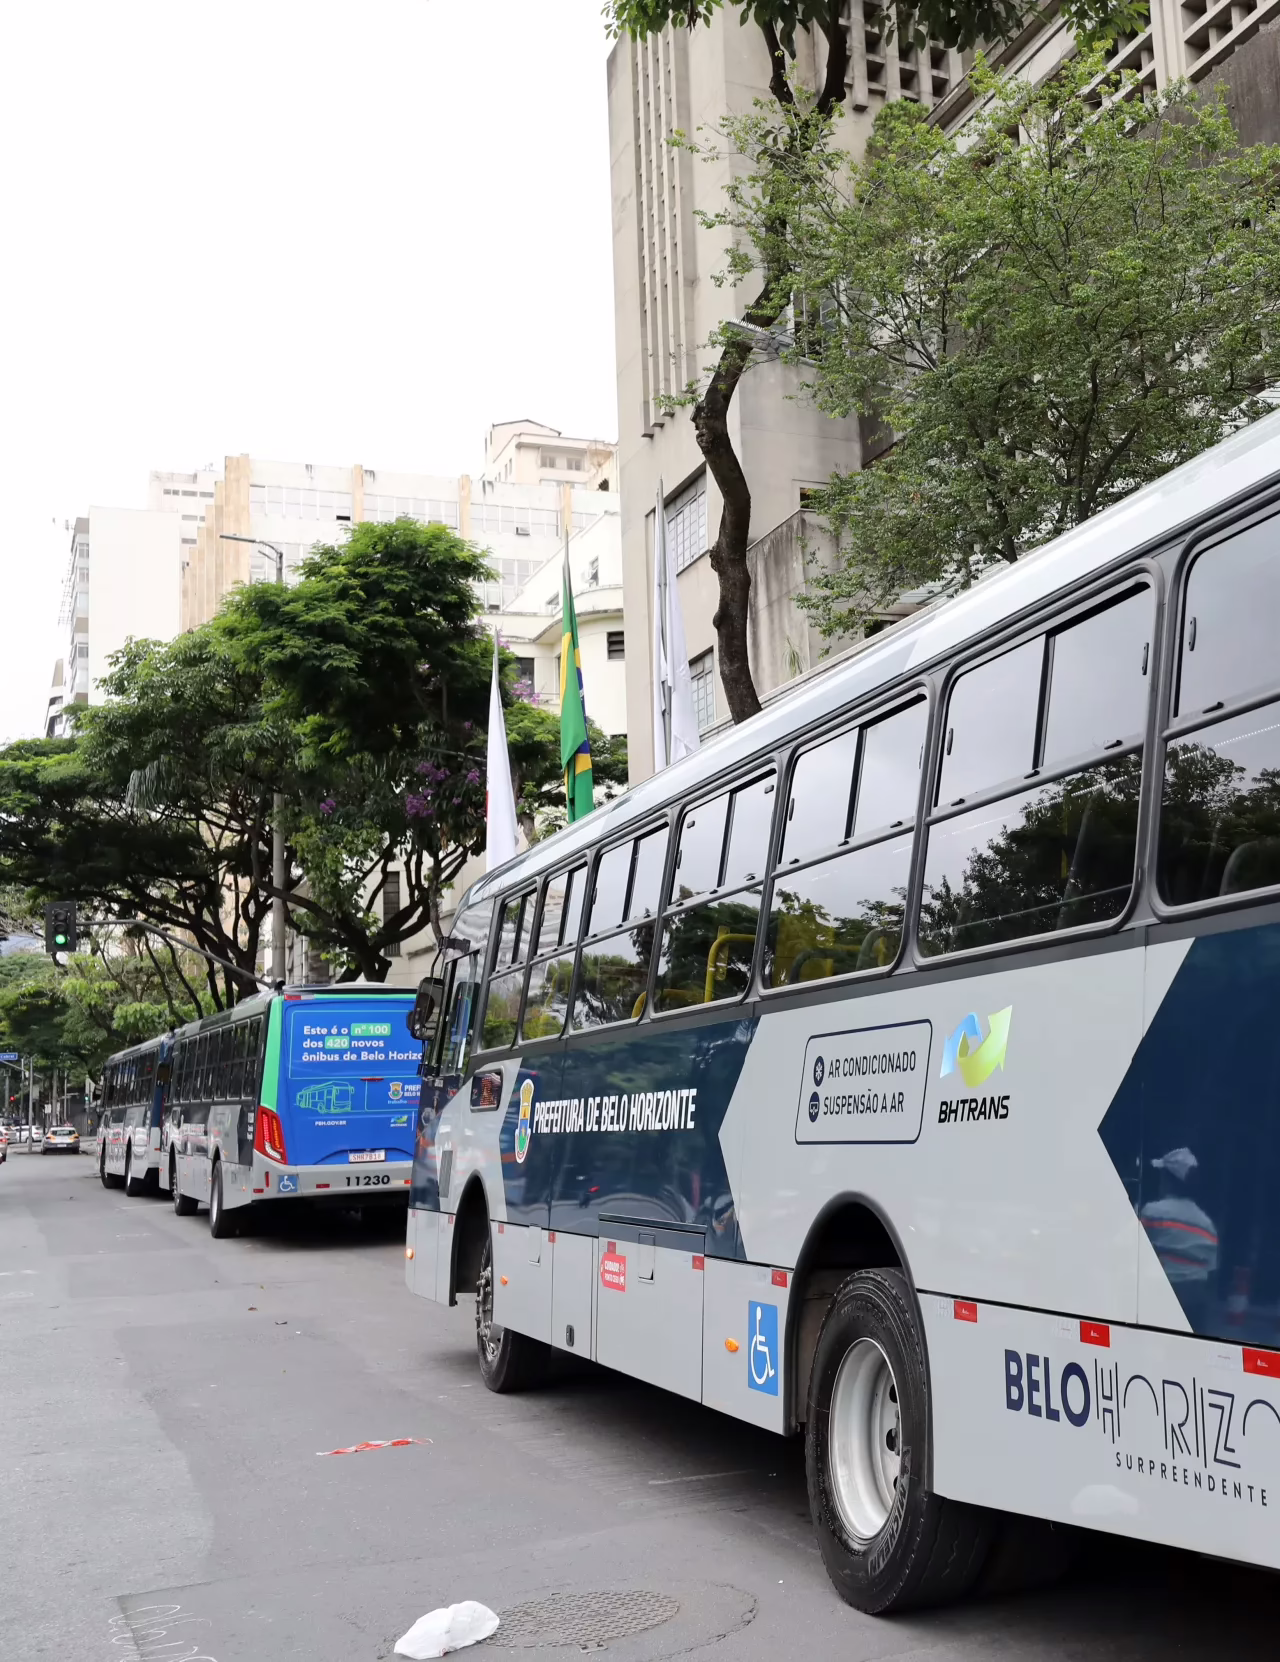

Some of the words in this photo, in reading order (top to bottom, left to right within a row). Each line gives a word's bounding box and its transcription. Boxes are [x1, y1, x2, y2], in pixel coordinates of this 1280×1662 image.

[302, 1038, 323, 1048] dos
[326, 1038, 348, 1047] 420
[351, 1039, 384, 1048] novos
[303, 1025, 328, 1035] Este
[331, 1025, 338, 1035] é
[341, 1027, 349, 1035] o
[369, 1025, 389, 1034] 100
[302, 1051, 339, 1062] ônibus
[343, 1051, 357, 1061] de
[361, 1051, 385, 1061] Belo
[828, 1058, 841, 1079] AR
[842, 1050, 916, 1077] CONDICIONADO
[533, 1097, 585, 1133] PREFEITURA
[586, 1097, 600, 1132] DE
[600, 1093, 627, 1132] BELO
[629, 1088, 698, 1131] HORIZONTE
[823, 1088, 878, 1116] SUSPENSÃO
[881, 1093, 888, 1114] A
[890, 1091, 905, 1113] AR
[938, 1095, 1010, 1123] BHTRANS
[345, 1174, 391, 1187] 11230
[1116, 1451, 1268, 1507] SURPREENDENTE
